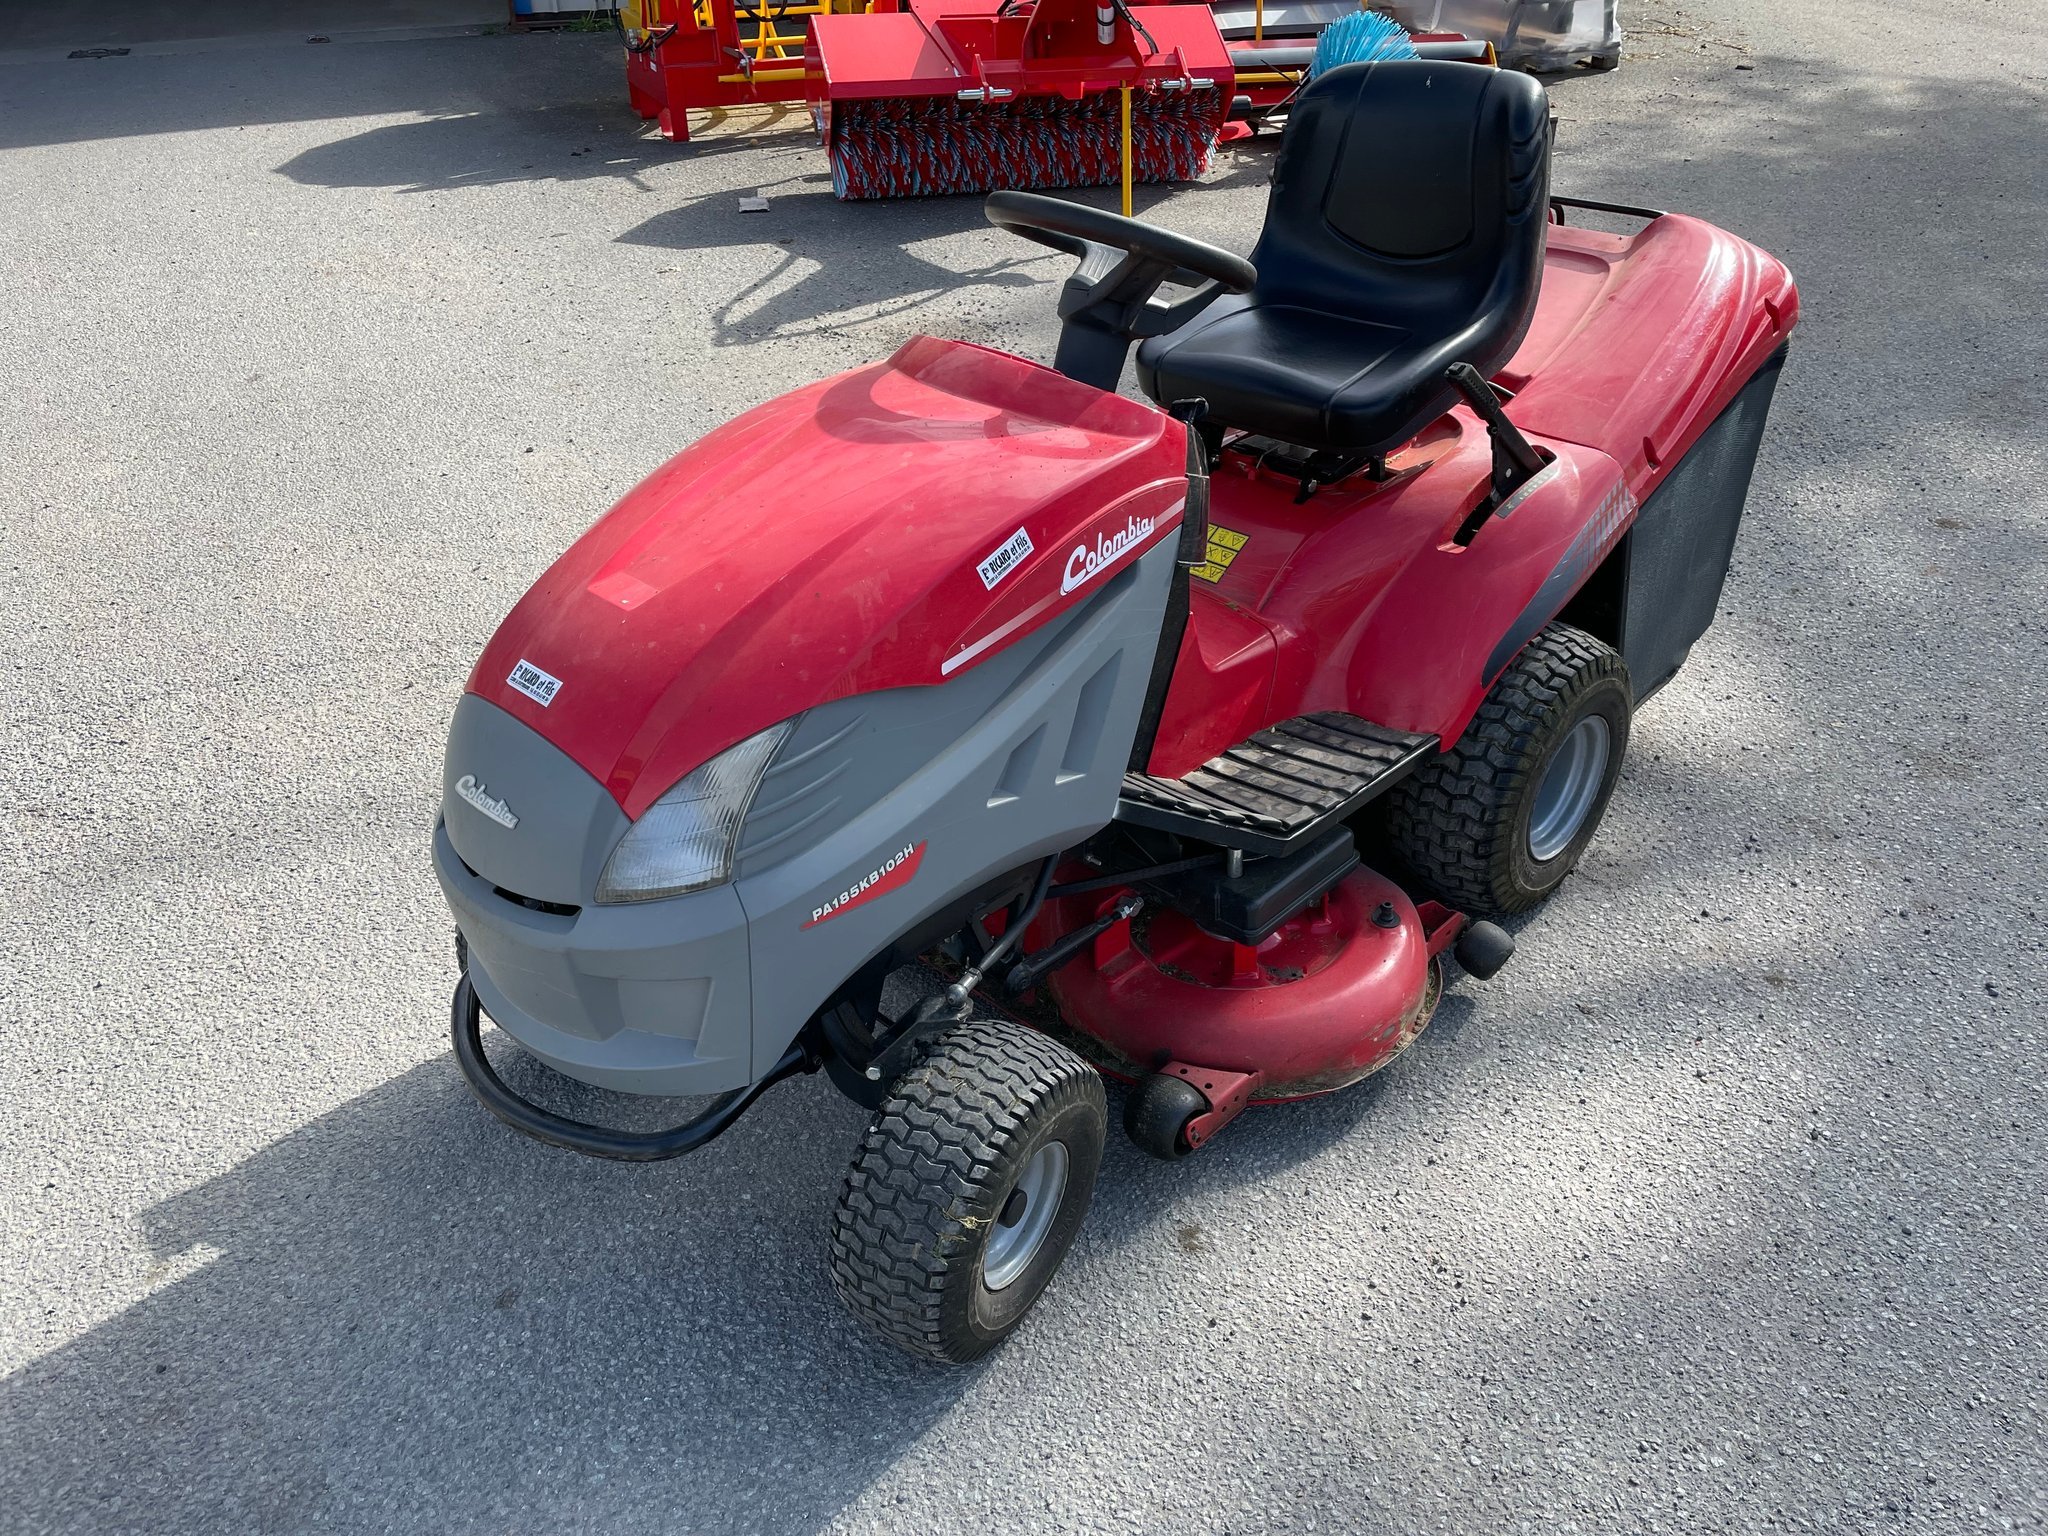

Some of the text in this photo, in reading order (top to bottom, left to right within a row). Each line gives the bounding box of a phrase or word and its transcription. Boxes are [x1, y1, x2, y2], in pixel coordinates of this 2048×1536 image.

[989, 548, 1011, 574] RICARD
[1010, 543, 1019, 556] et
[1015, 535, 1028, 551] Fils
[1060, 515, 1155, 595] Colombia
[519, 667, 541, 687] RICARD
[536, 680, 547, 691] et
[542, 680, 556, 697] Fils
[455, 775, 519, 829] Colombia
[812, 843, 914, 921] PA185KB102H
